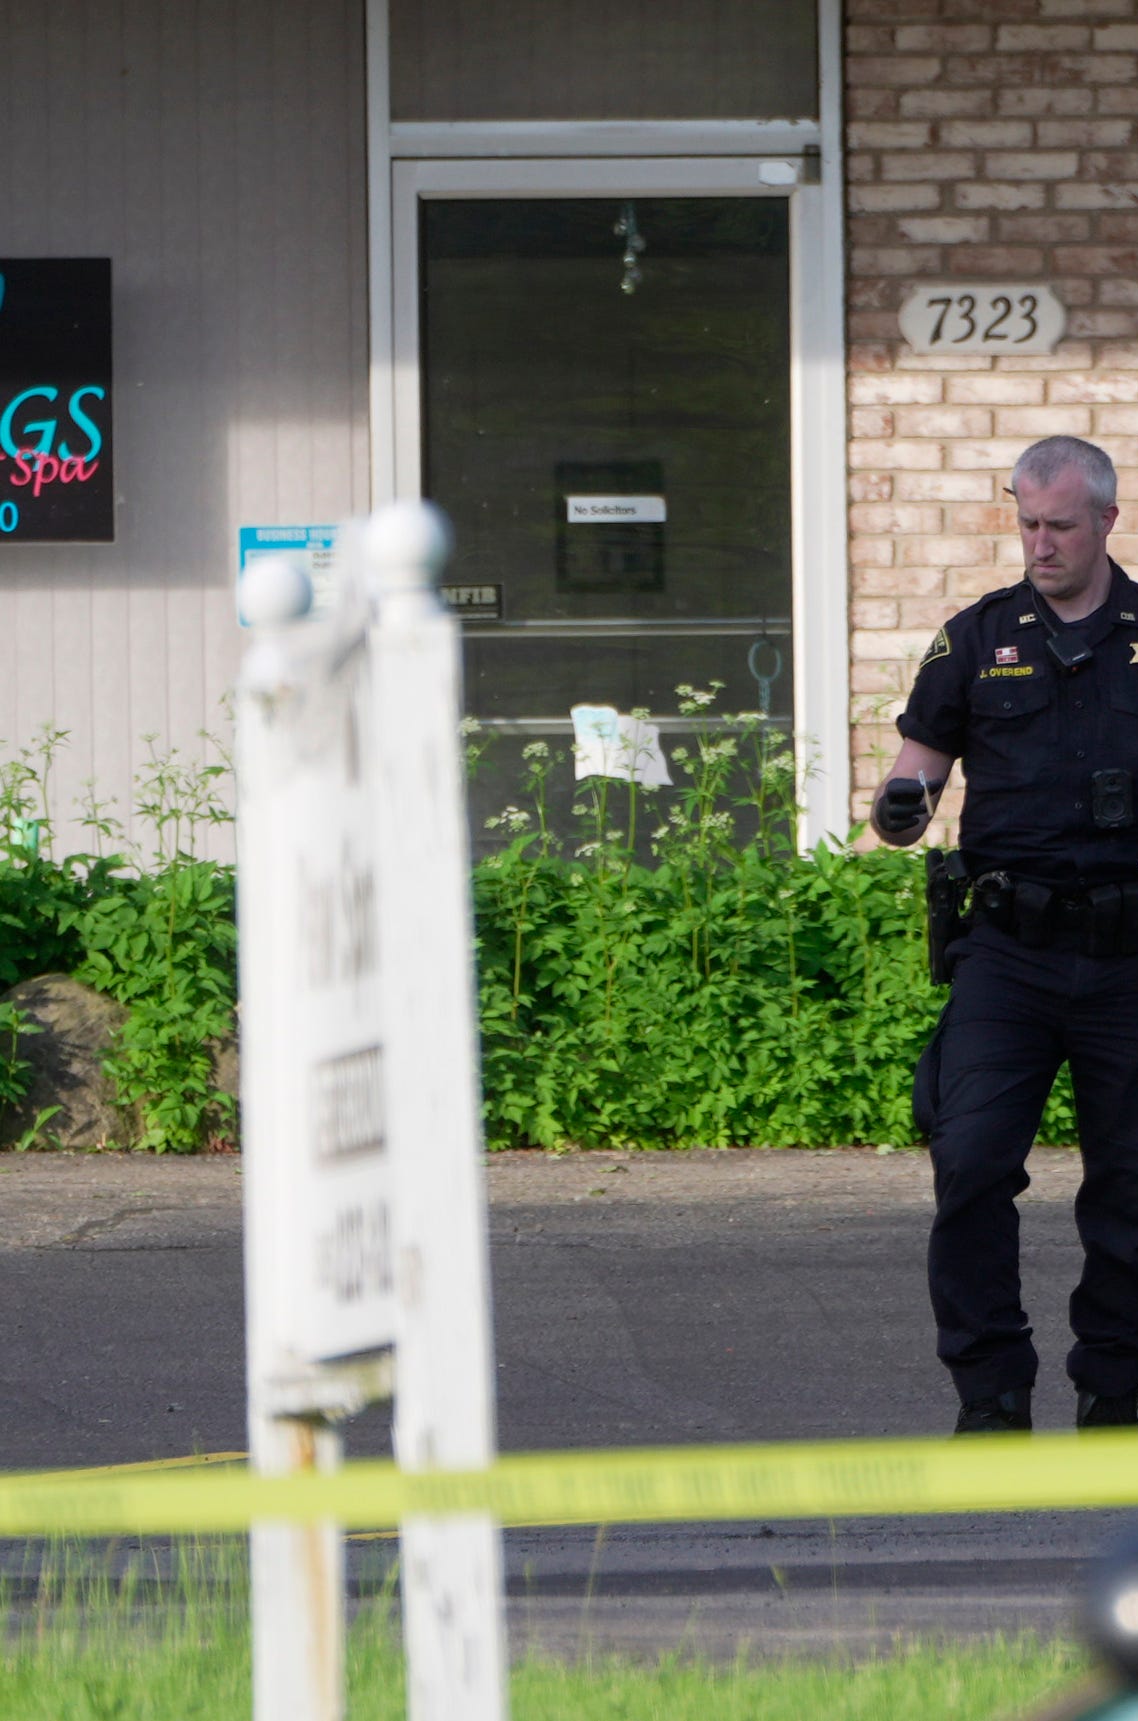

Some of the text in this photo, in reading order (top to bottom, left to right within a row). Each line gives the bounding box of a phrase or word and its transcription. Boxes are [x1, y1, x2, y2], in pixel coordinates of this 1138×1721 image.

[926, 294, 1038, 345] 7323
[9, 447, 99, 497] Spa
[574, 505, 637, 516] No Solicitors
[989, 666, 1034, 678] OVEREND
